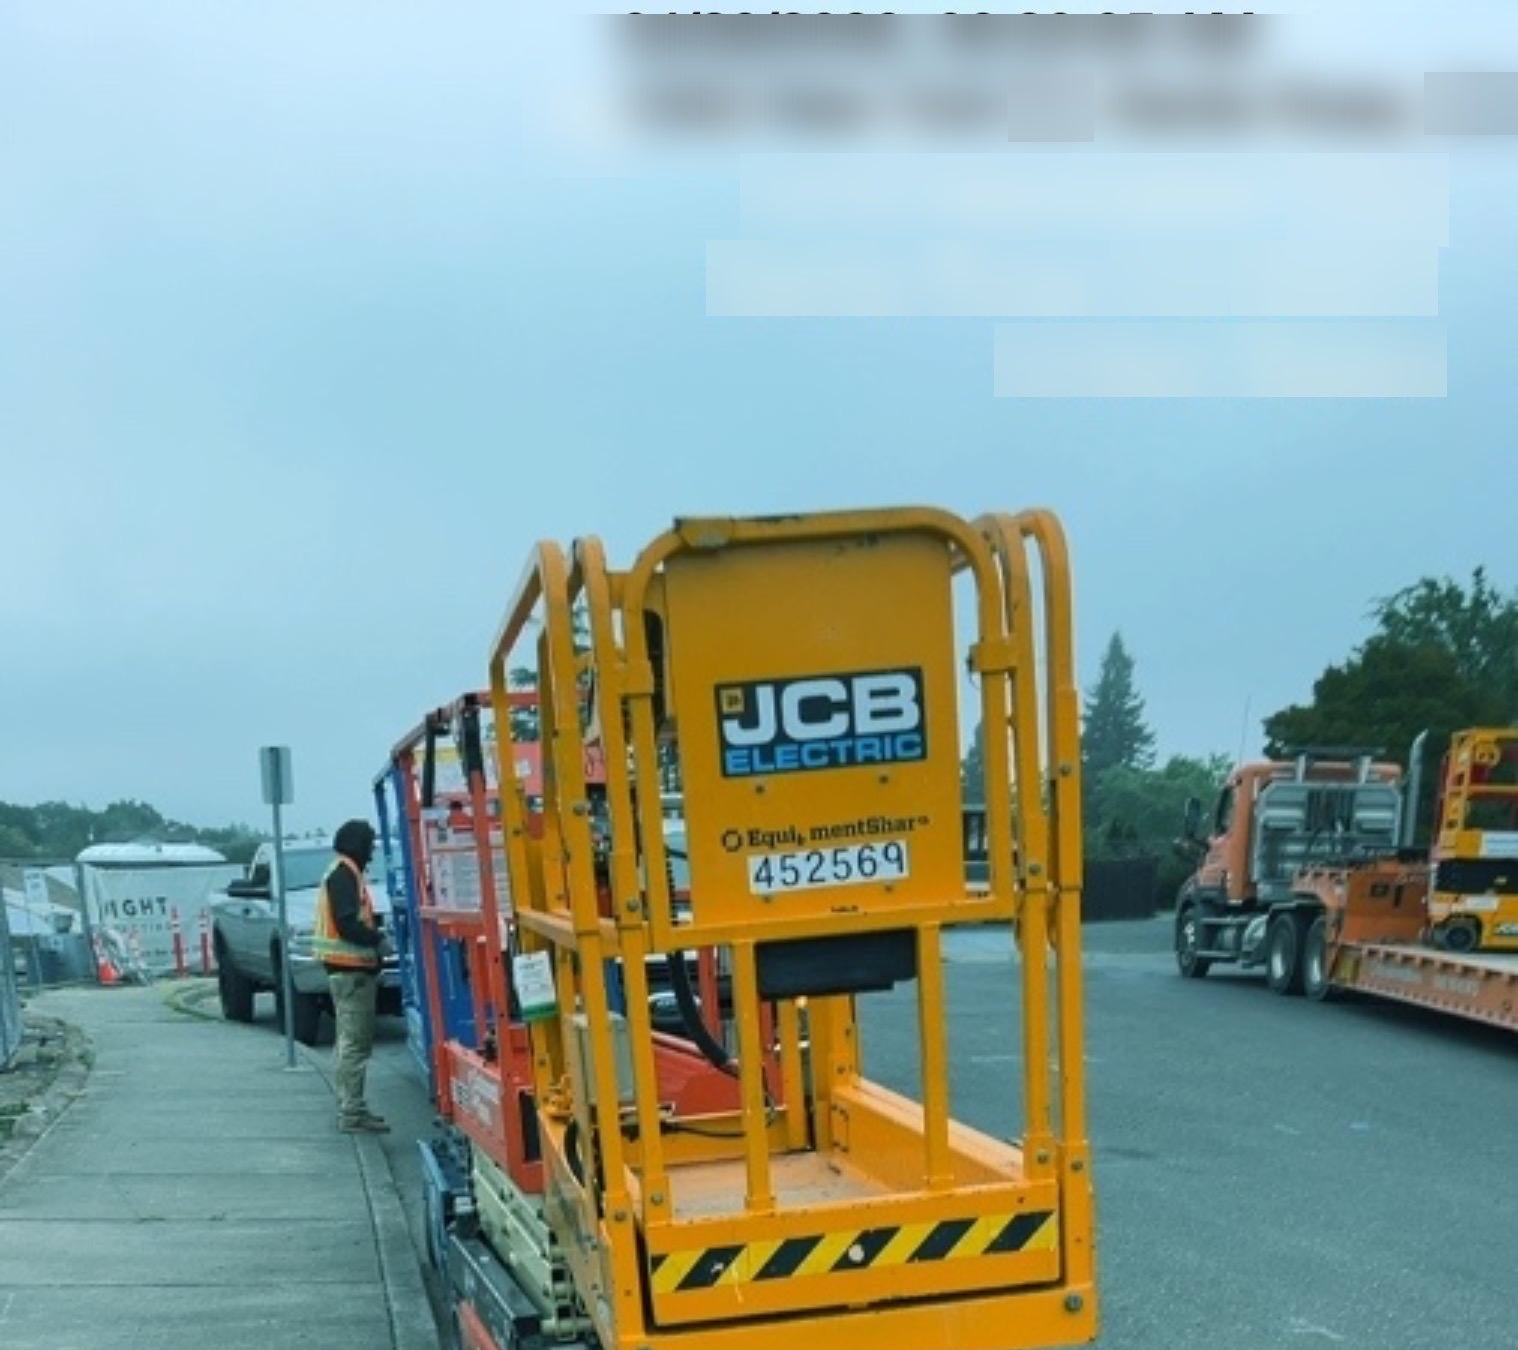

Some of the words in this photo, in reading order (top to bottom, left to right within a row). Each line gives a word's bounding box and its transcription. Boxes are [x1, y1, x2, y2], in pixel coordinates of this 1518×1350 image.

[722, 673, 920, 746] JCB
[725, 732, 923, 775] ELECTRIC
[754, 841, 905, 888] 452569
